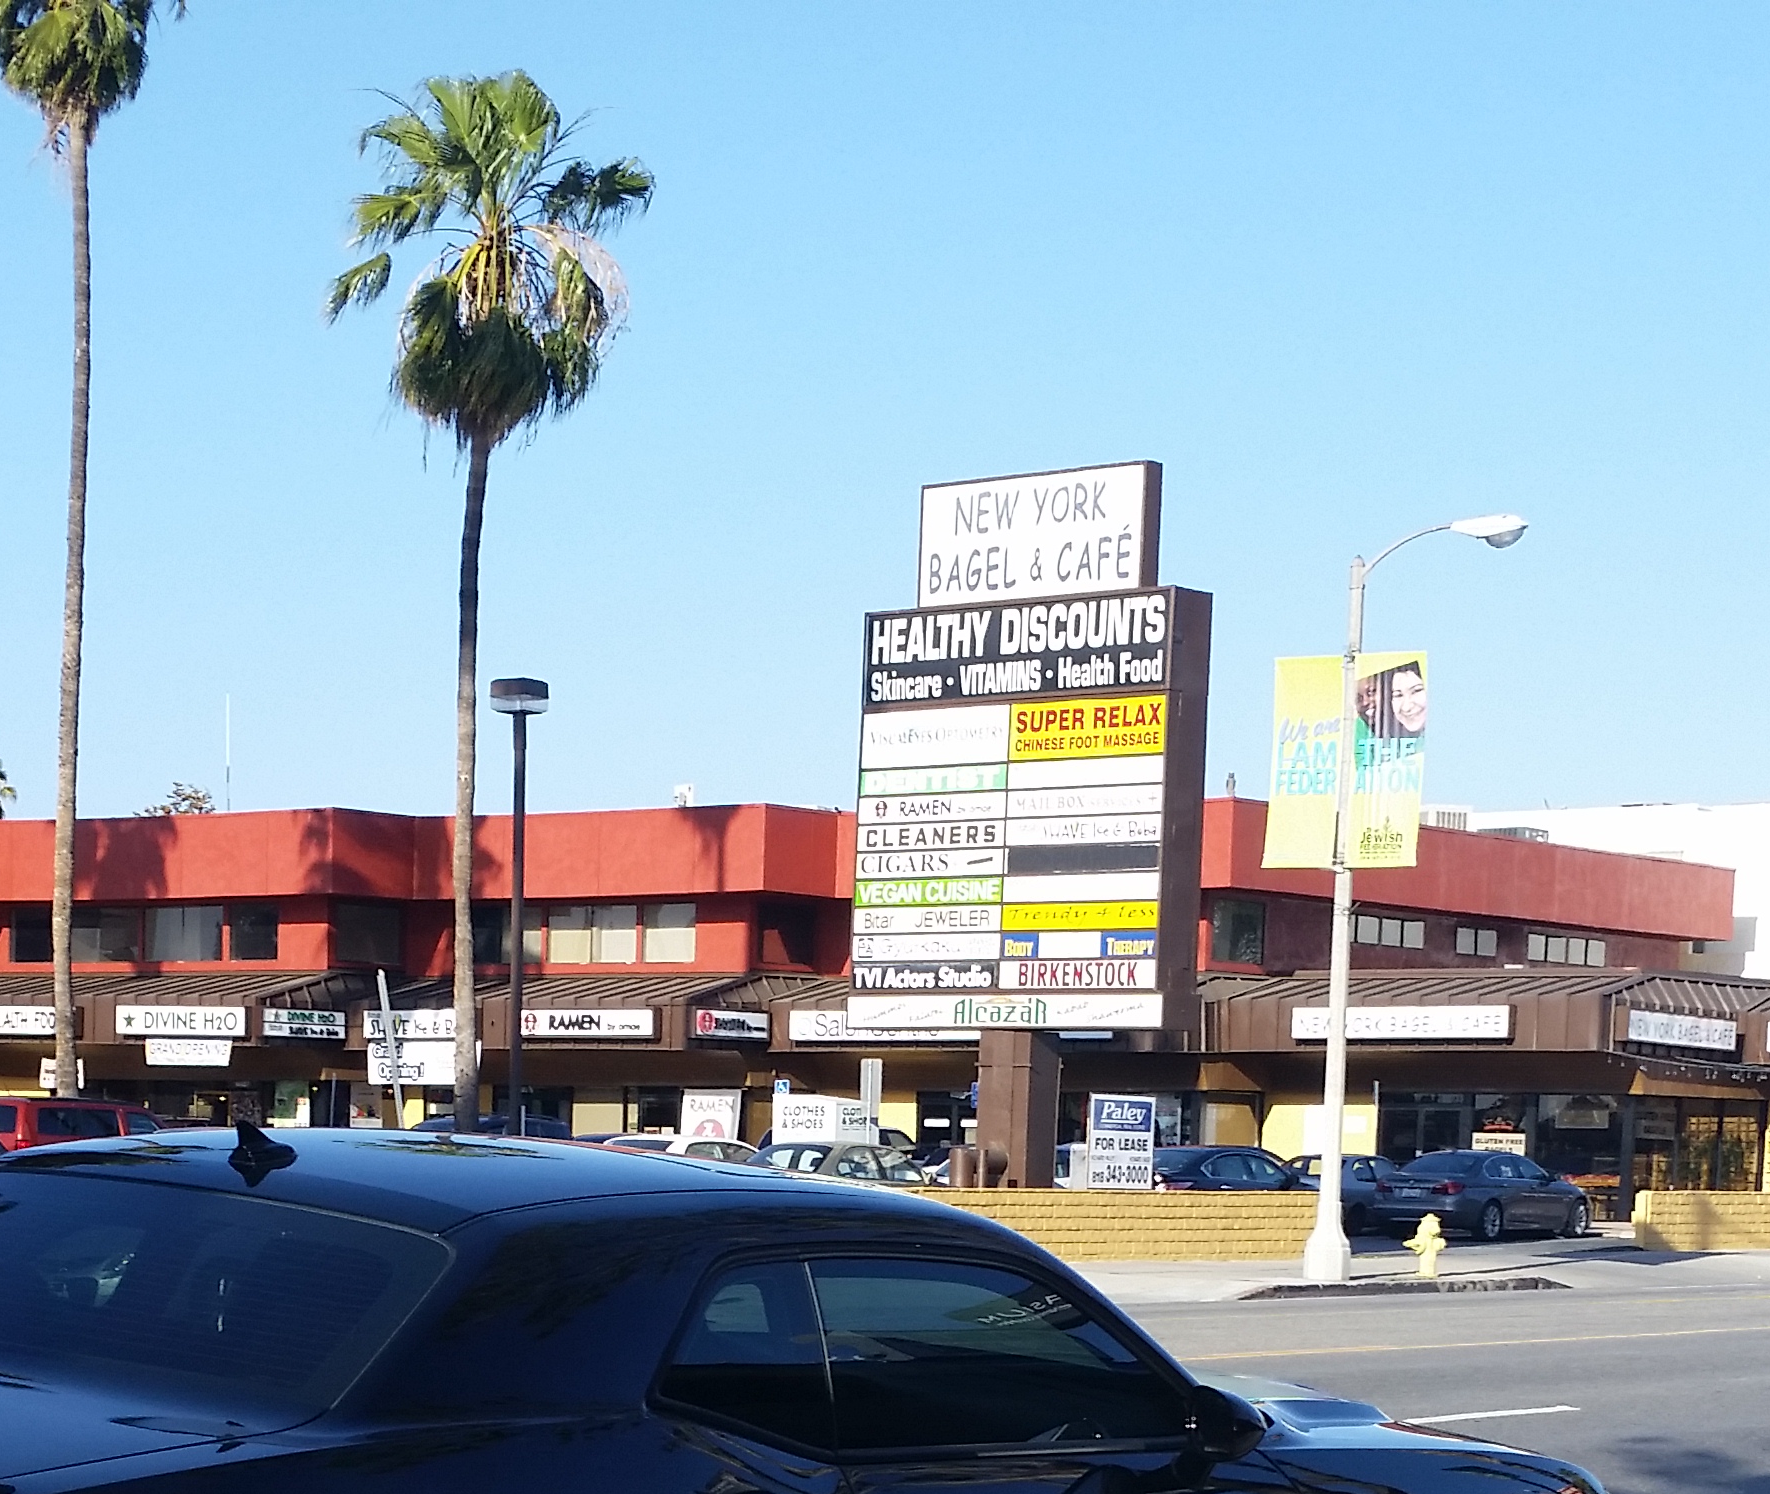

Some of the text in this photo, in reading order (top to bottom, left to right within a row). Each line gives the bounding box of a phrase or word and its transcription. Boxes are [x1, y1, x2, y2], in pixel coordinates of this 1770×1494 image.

[954, 480, 1107, 537] NEW YORK
[928, 523, 1132, 595] BAGEL & CAFÉ
[870, 593, 1167, 666] HEALTHY DISCOUNTS
[870, 649, 1164, 702] Skincare VITAMINS Health Food
[1015, 702, 1163, 734] SUPER RELAX
[1015, 731, 1160, 752] CHINESE FOOT MASSAGE
[1357, 737, 1417, 767] THE
[1291, 740, 1338, 769] AM
[864, 766, 1002, 792] DENTIST
[1275, 768, 1338, 796] FEDER
[899, 799, 953, 817] RAMEN
[1057, 795, 1085, 809] BOX
[865, 824, 997, 849] CLEANERS
[860, 853, 950, 874] CIGARS
[858, 878, 1001, 904] VEGAN CUISINE
[863, 909, 991, 930] Bitar JEWELER
[1008, 906, 1089, 926] Trendy
[853, 964, 993, 989] TVI Actors Studio
[1017, 960, 1138, 987] BIRKENSTOCK
[33, 1011, 56, 1029] FOO
[143, 1011, 238, 1031] DIVINE H2O
[370, 1017, 410, 1036] SHVE
[548, 1013, 601, 1031] RAMEN
[1343, 1016, 1382, 1035] ORK
[689, 1097, 736, 1114] RAMEN
[782, 1105, 826, 1117] CLOTHES
[1100, 1101, 1148, 1121] Paley
[790, 1118, 824, 1129] SHOES
[1094, 1137, 1149, 1152] FOR LEASE
